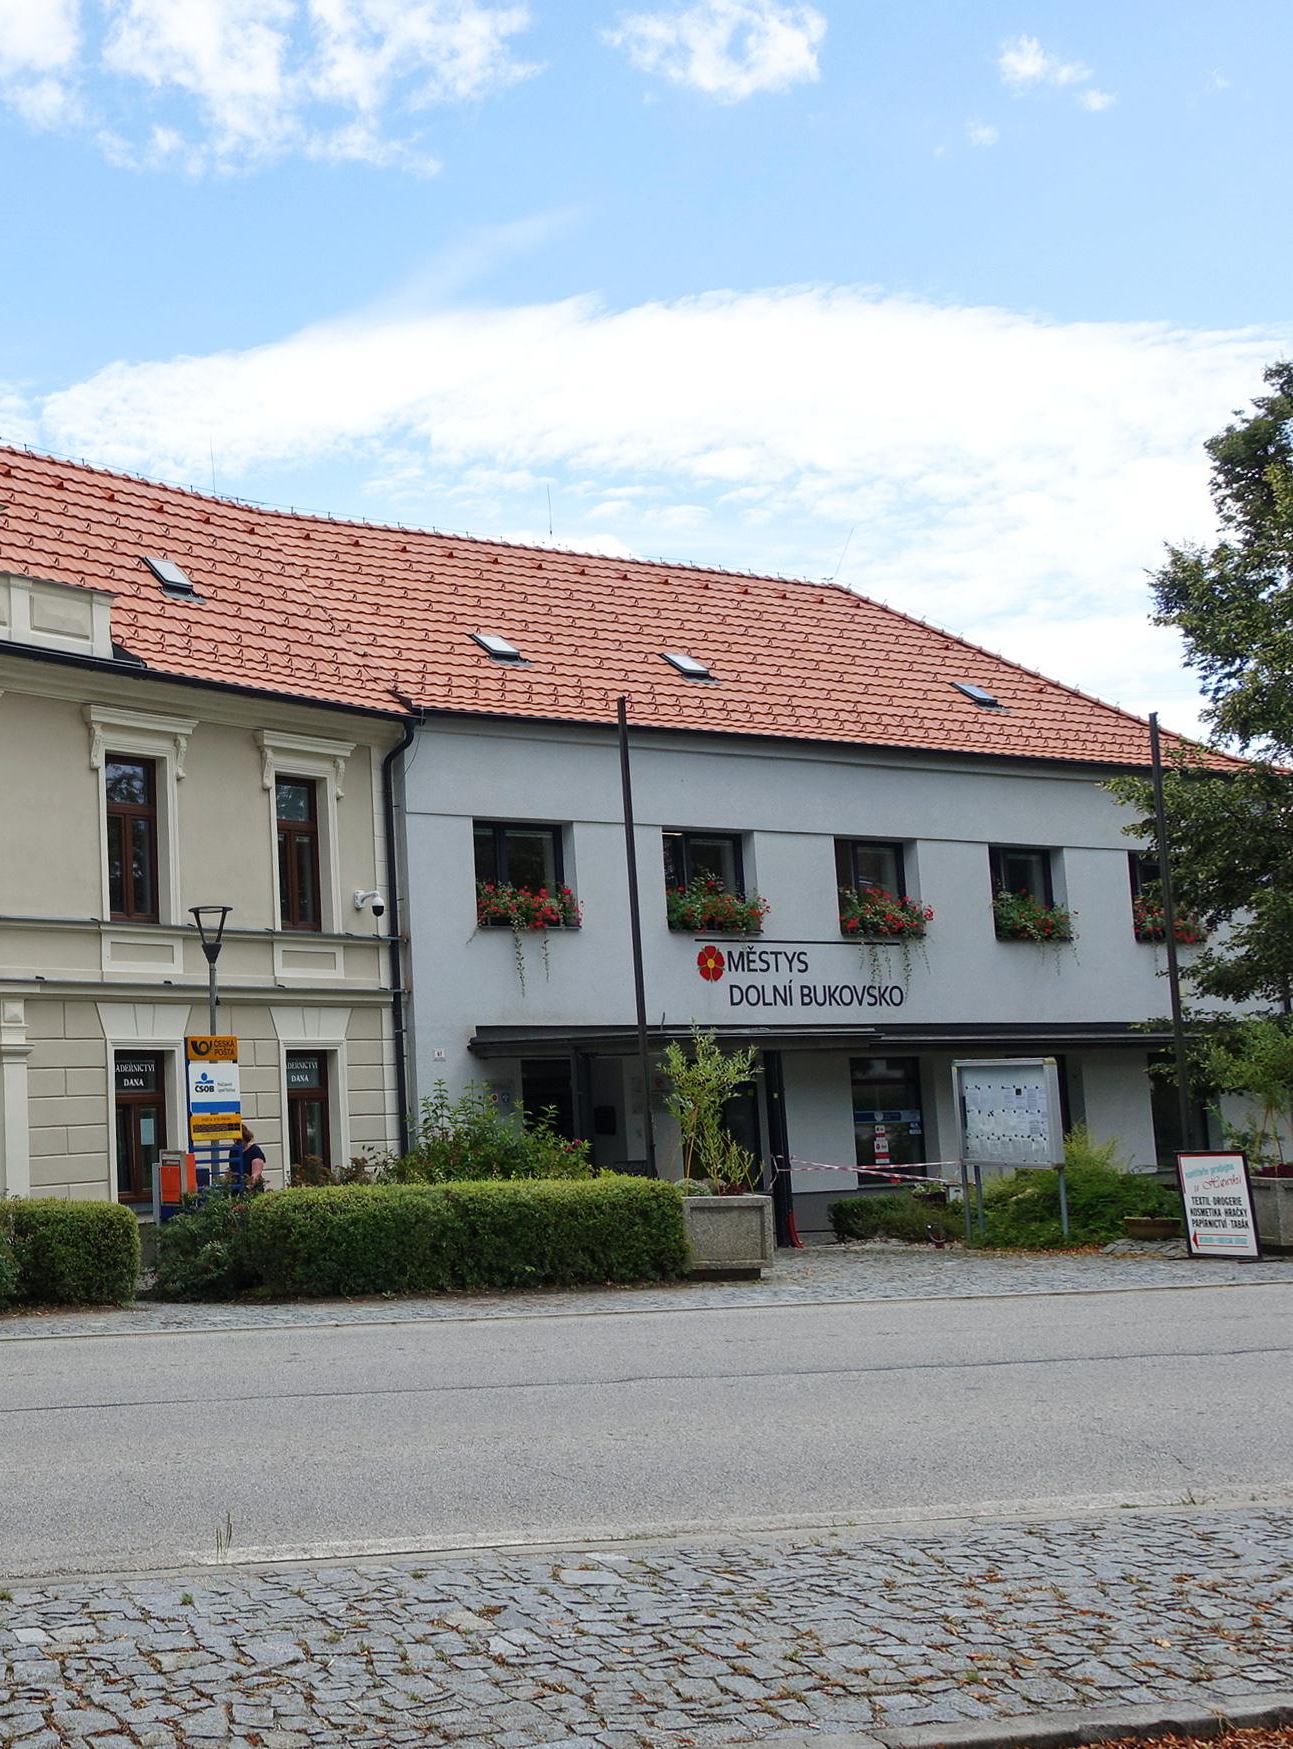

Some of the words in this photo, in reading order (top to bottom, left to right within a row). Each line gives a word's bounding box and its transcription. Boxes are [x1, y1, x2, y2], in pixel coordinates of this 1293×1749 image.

[727, 945, 809, 973] MĚSTYS
[729, 979, 793, 1007] DOLNÍ
[800, 984, 904, 1007] BUKOVSKO
[123, 1078, 144, 1087] DANA
[291, 1074, 309, 1083] DANA
[1191, 1196, 1211, 1206] TEXTIL
[1213, 1196, 1243, 1206] DROGERIE
[1190, 1207, 1222, 1217] KOSMETIKA
[1224, 1206, 1248, 1218] HRAČKY
